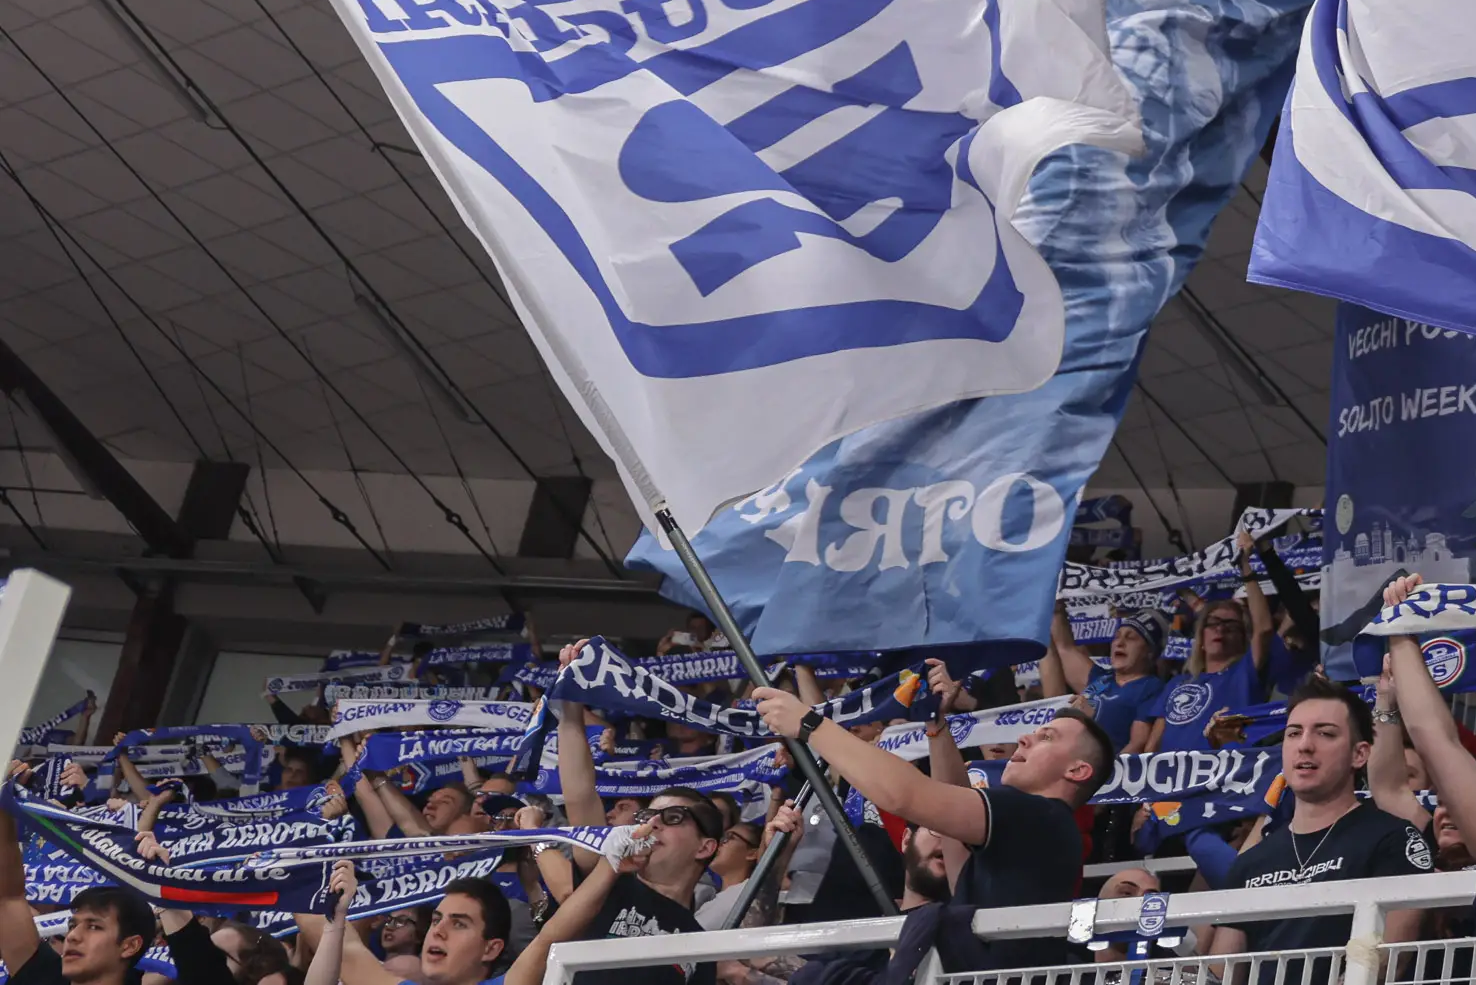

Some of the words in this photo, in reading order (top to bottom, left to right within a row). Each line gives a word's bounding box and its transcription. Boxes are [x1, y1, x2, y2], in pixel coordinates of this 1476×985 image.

[1348, 318, 1398, 360] VECCHI
[1338, 396, 1394, 438] SOLITO
[399, 739, 424, 761] LA
[428, 735, 499, 758] NOSTRA
